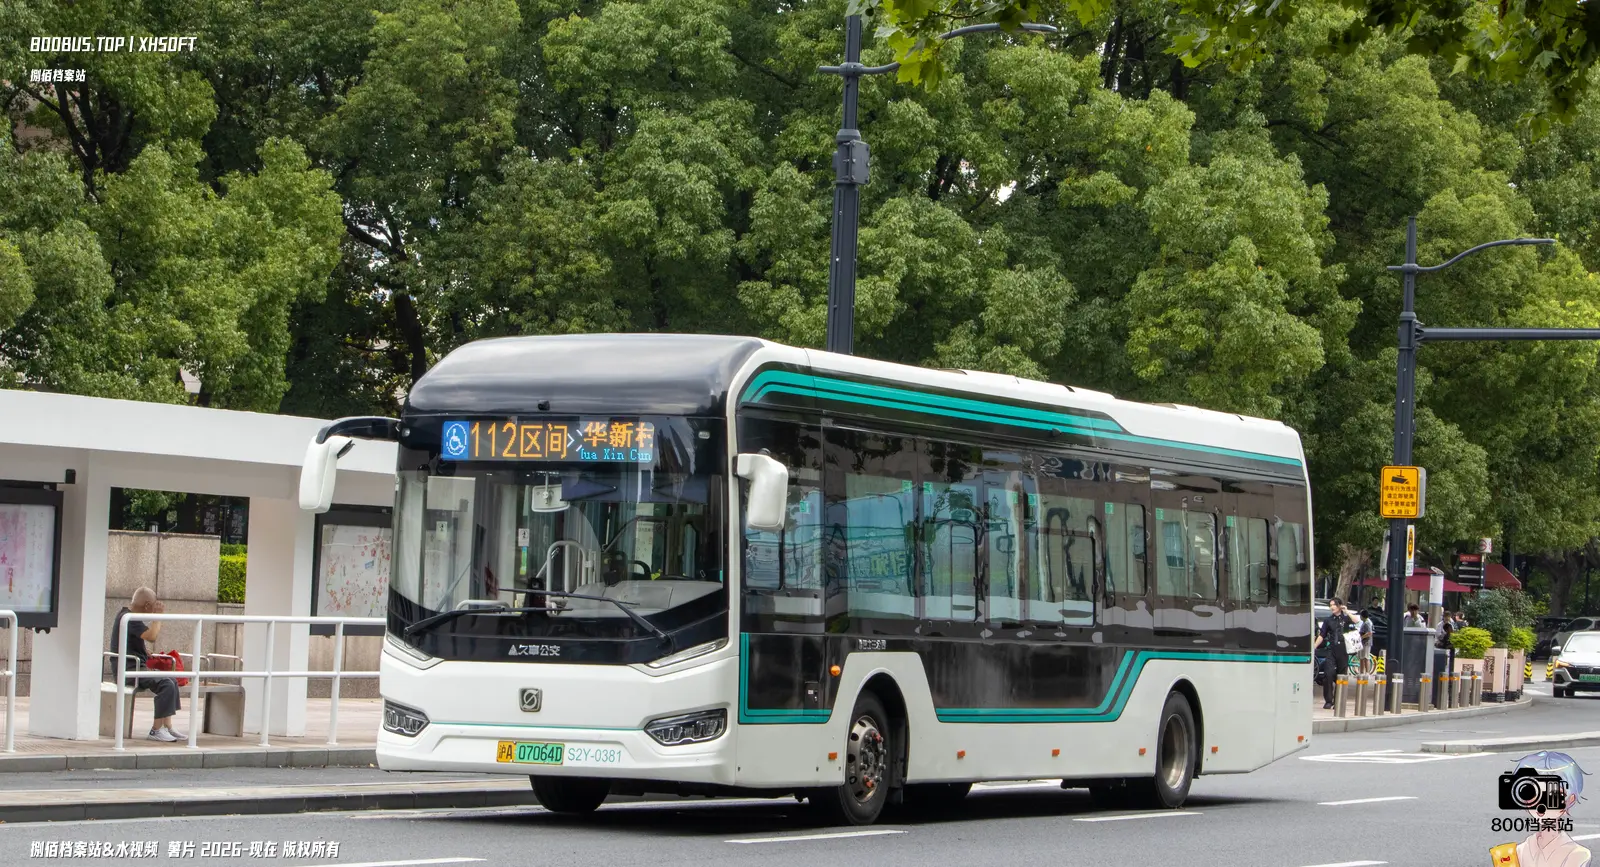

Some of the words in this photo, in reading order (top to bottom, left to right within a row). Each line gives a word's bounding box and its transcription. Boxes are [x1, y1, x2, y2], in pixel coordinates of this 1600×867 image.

[471, 422, 568, 459] 112区间
[583, 421, 654, 448] 华新村
[603, 448, 624, 460] Xin
[630, 449, 652, 461] Cun
[568, 747, 621, 763] S2Y-0381
